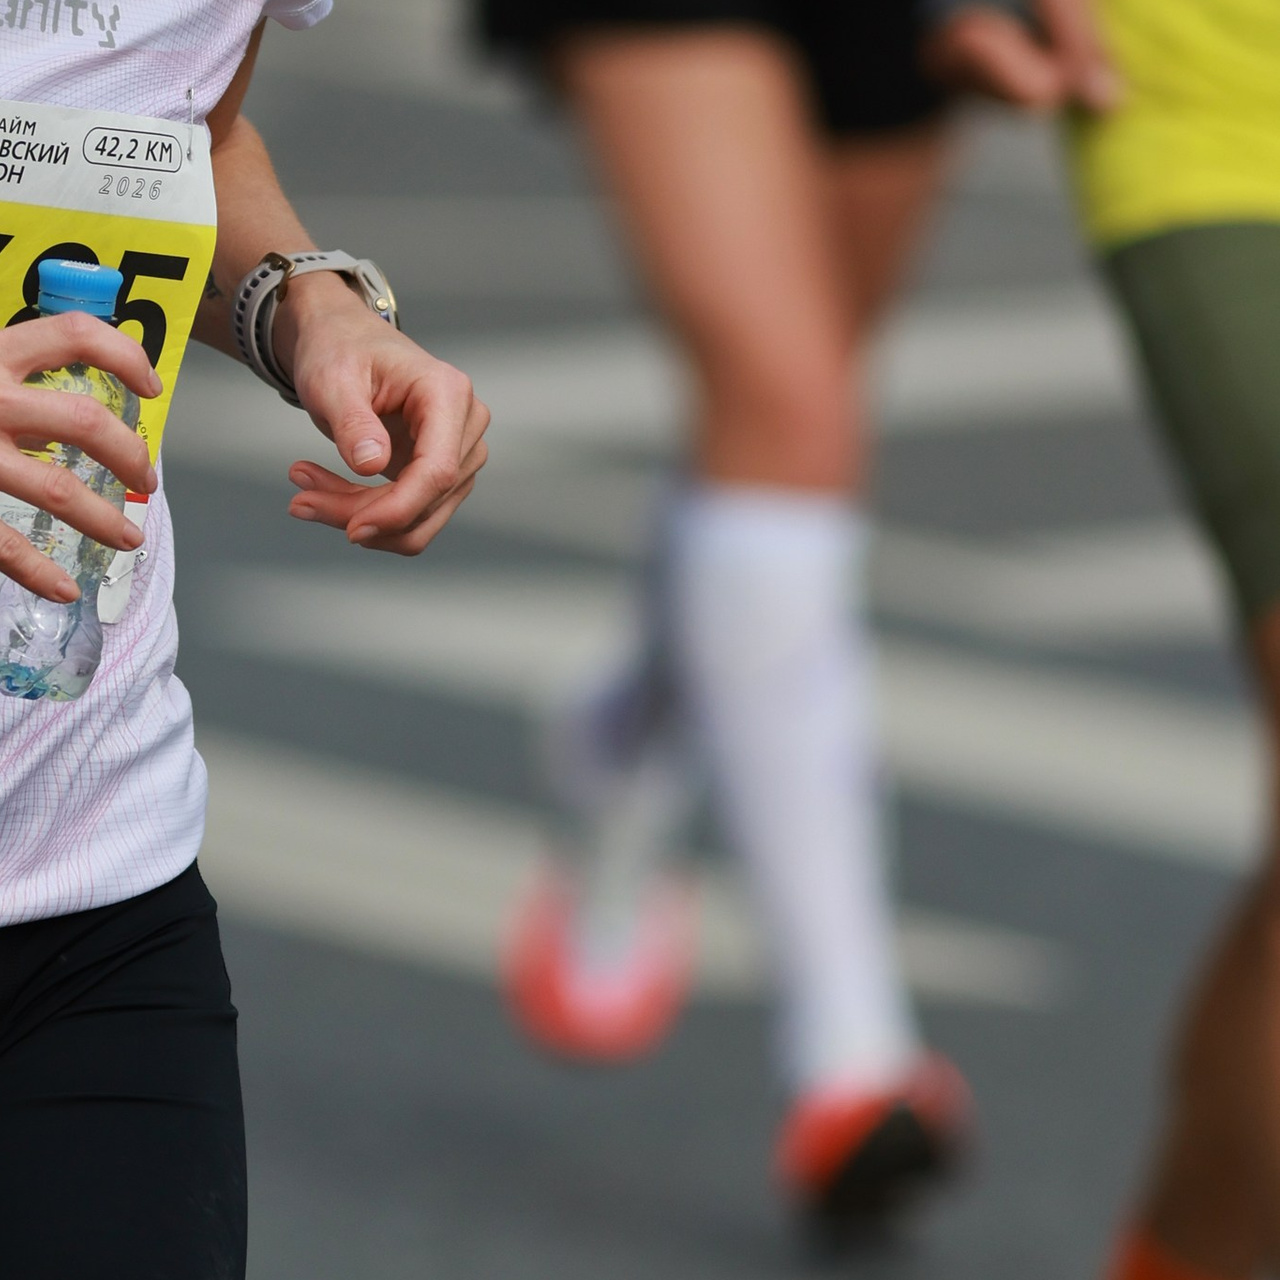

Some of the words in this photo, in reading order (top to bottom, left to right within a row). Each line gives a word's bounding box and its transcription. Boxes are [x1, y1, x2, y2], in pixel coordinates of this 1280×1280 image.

[94, 135, 140, 162] 42,2
[145, 141, 174, 164] КМ
[98, 174, 163, 201] 2026
